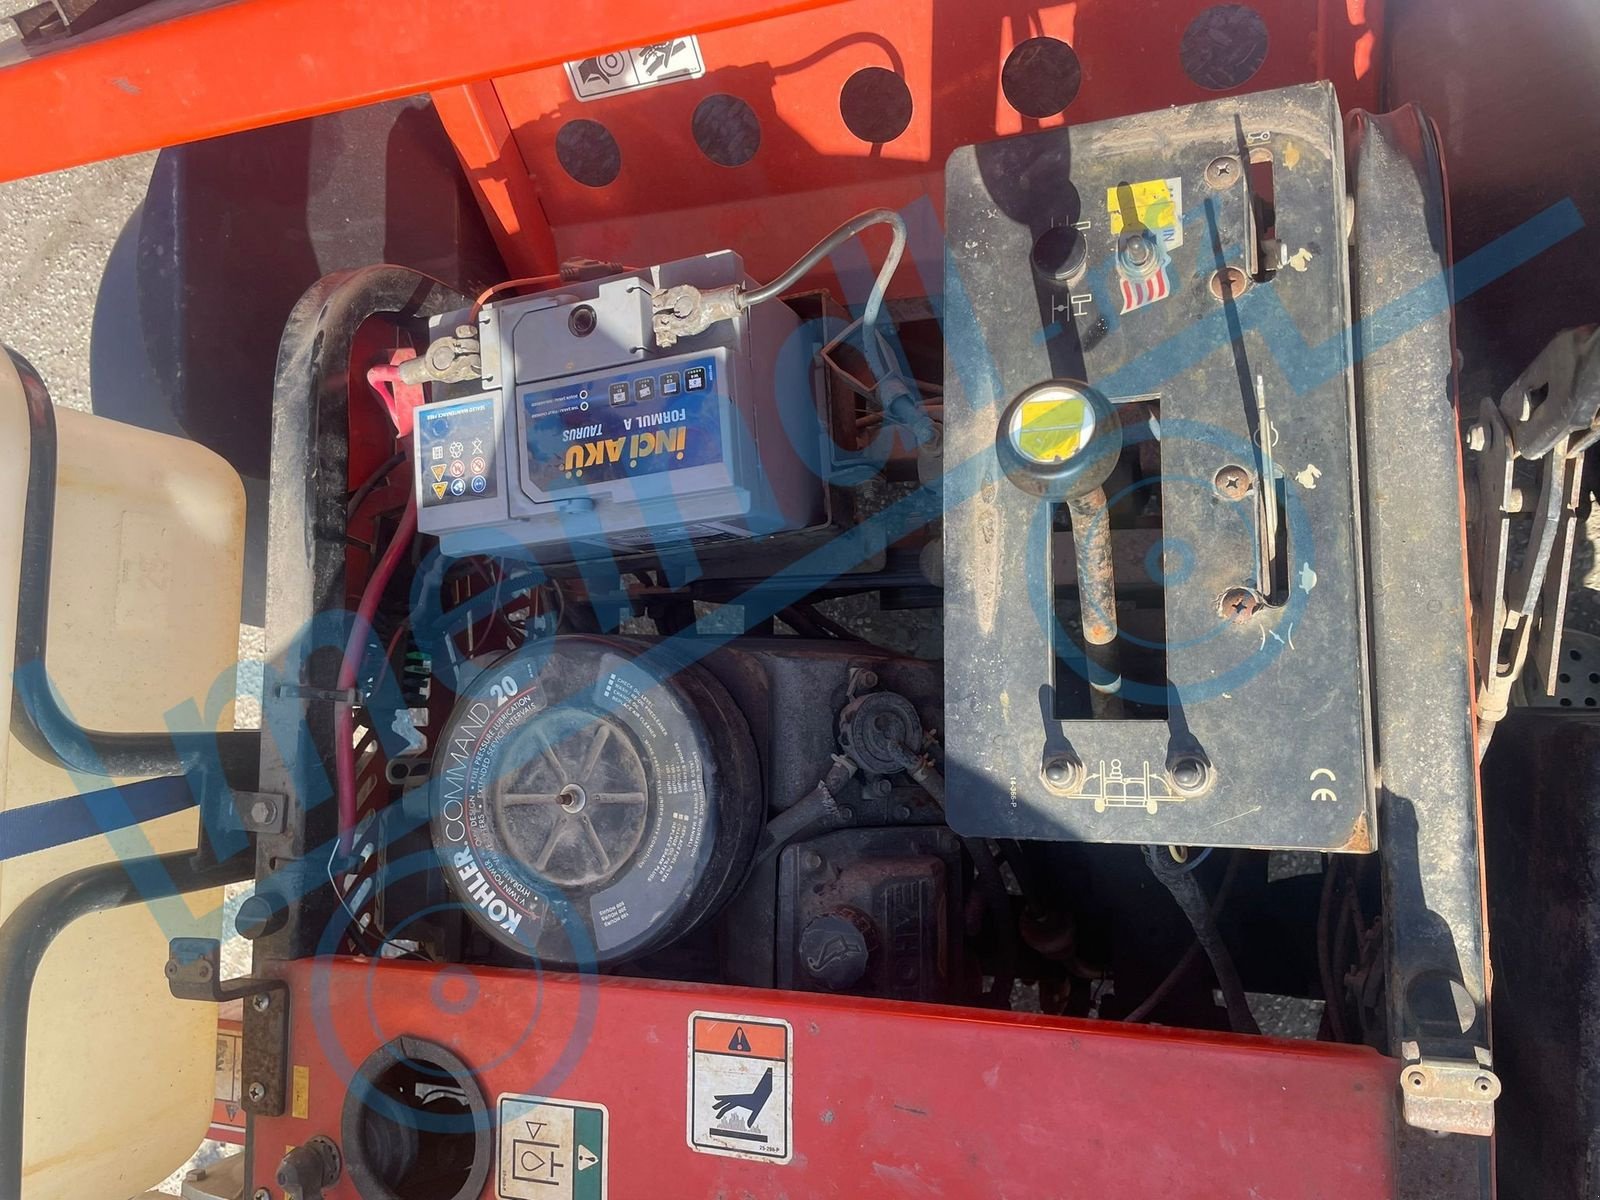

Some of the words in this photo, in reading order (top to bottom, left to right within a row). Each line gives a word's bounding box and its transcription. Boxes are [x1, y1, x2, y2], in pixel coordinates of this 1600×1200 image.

[562, 424, 603, 441] TAURUS
[623, 418, 632, 430] A
[635, 408, 686, 427] FORMUL
[564, 436, 626, 479] AKÜ
[489, 674, 519, 707] 20
[492, 695, 530, 730] LUBRICATION
[505, 702, 536, 729] INTERVALS
[474, 730, 494, 765] PRESSURE
[486, 728, 506, 757] SERVICE
[443, 702, 491, 843] COMMAND
[470, 766, 479, 782] FULL
[477, 757, 491, 797] EXTENDED
[483, 859, 504, 885] POWER
[498, 864, 530, 896] HYDRAULIC
[454, 846, 523, 936] KOHLER
